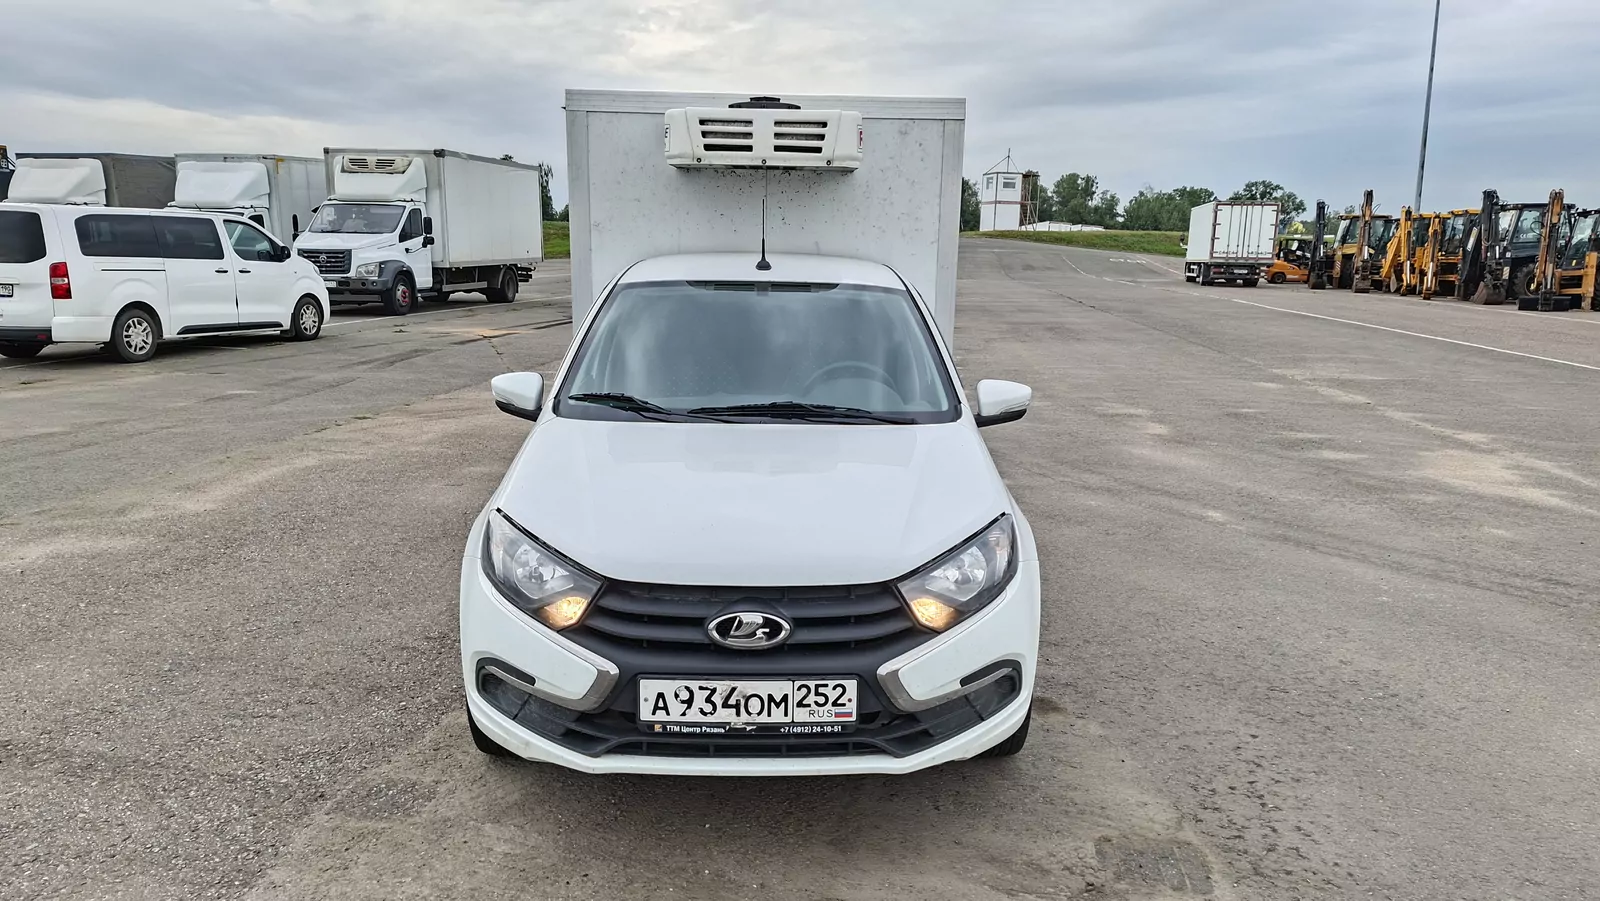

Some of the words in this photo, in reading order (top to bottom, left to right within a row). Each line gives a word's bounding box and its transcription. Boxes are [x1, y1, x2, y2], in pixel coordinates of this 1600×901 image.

[796, 683, 847, 708] 252
[808, 709, 833, 718] RUS
[681, 725, 700, 733] Центр
